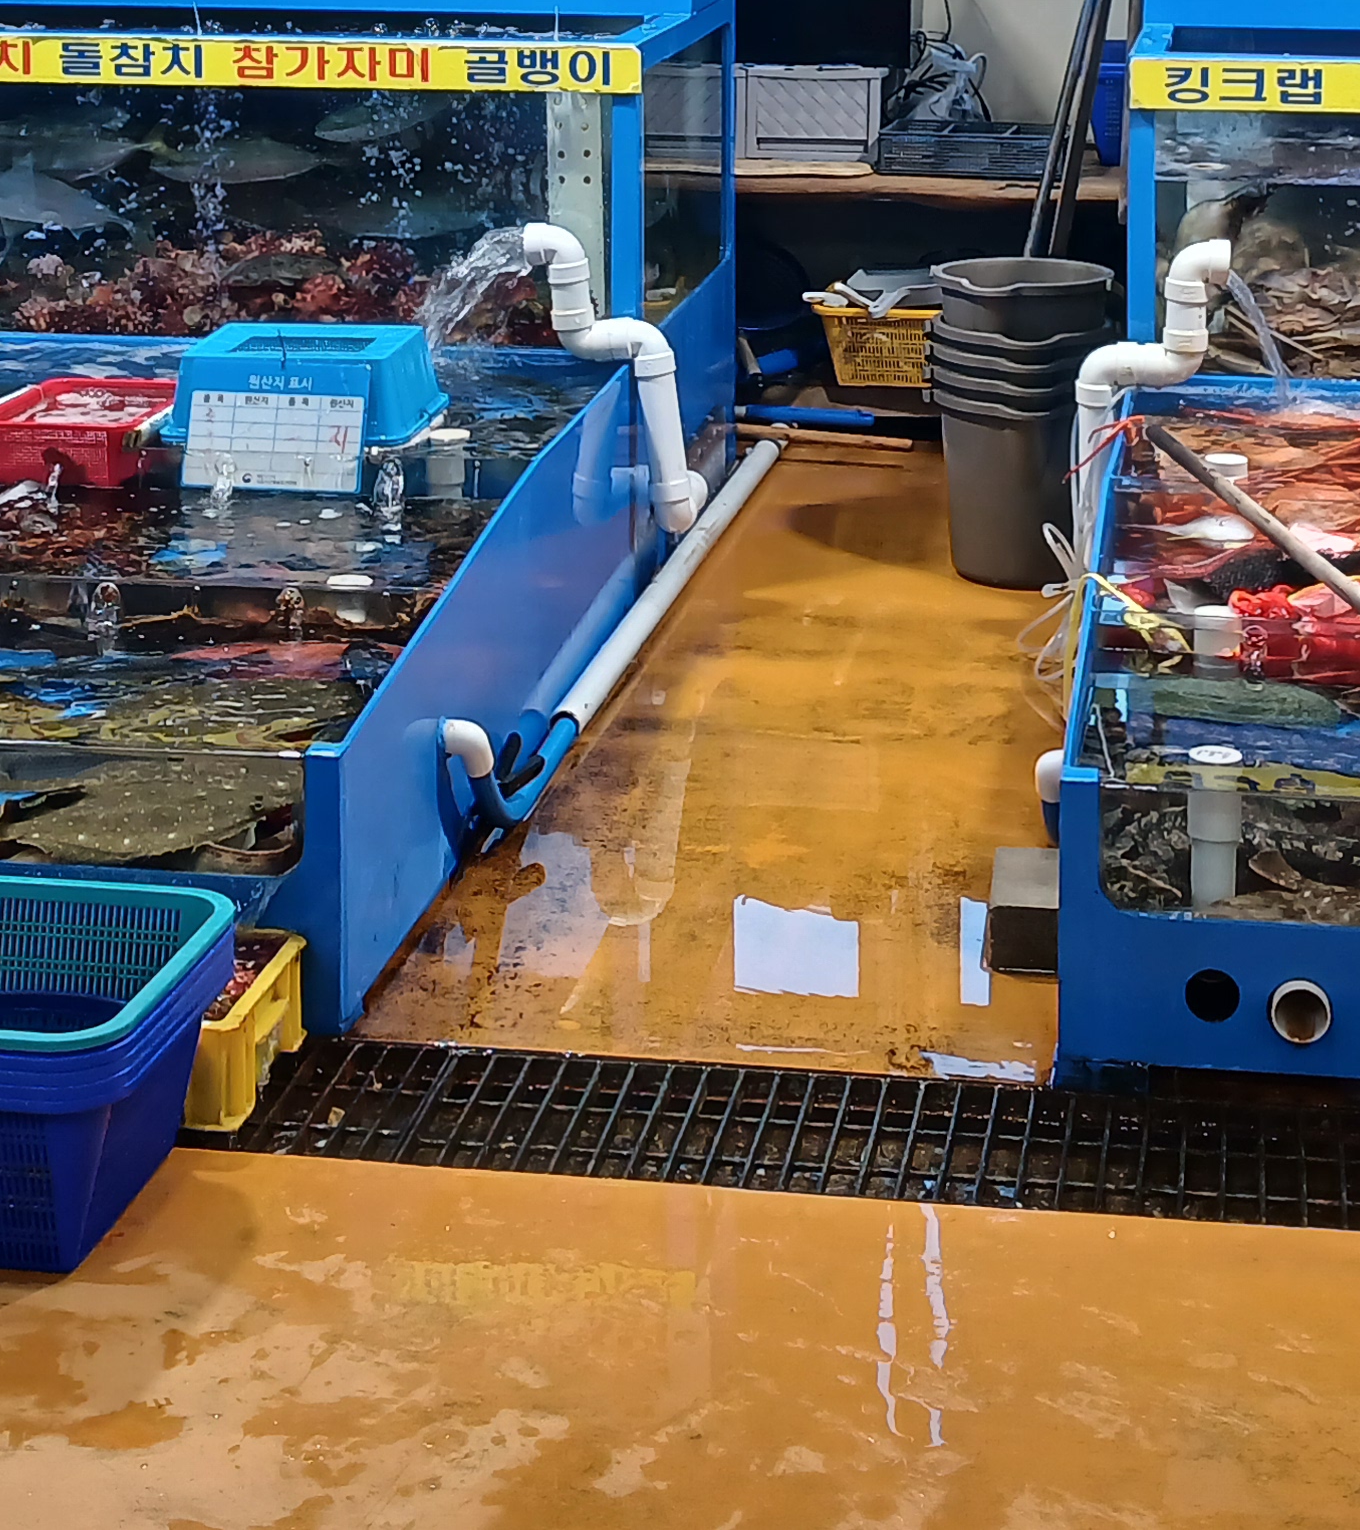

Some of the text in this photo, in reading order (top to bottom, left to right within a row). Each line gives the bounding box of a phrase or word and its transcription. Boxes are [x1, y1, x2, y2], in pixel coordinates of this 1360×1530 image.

[58, 40, 204, 80] 돌참치
[231, 41, 432, 84] 참가자미
[463, 45, 613, 88] 골뱅이
[1163, 65, 1325, 105] 킹크랩
[247, 374, 313, 391] 원산지 표시
